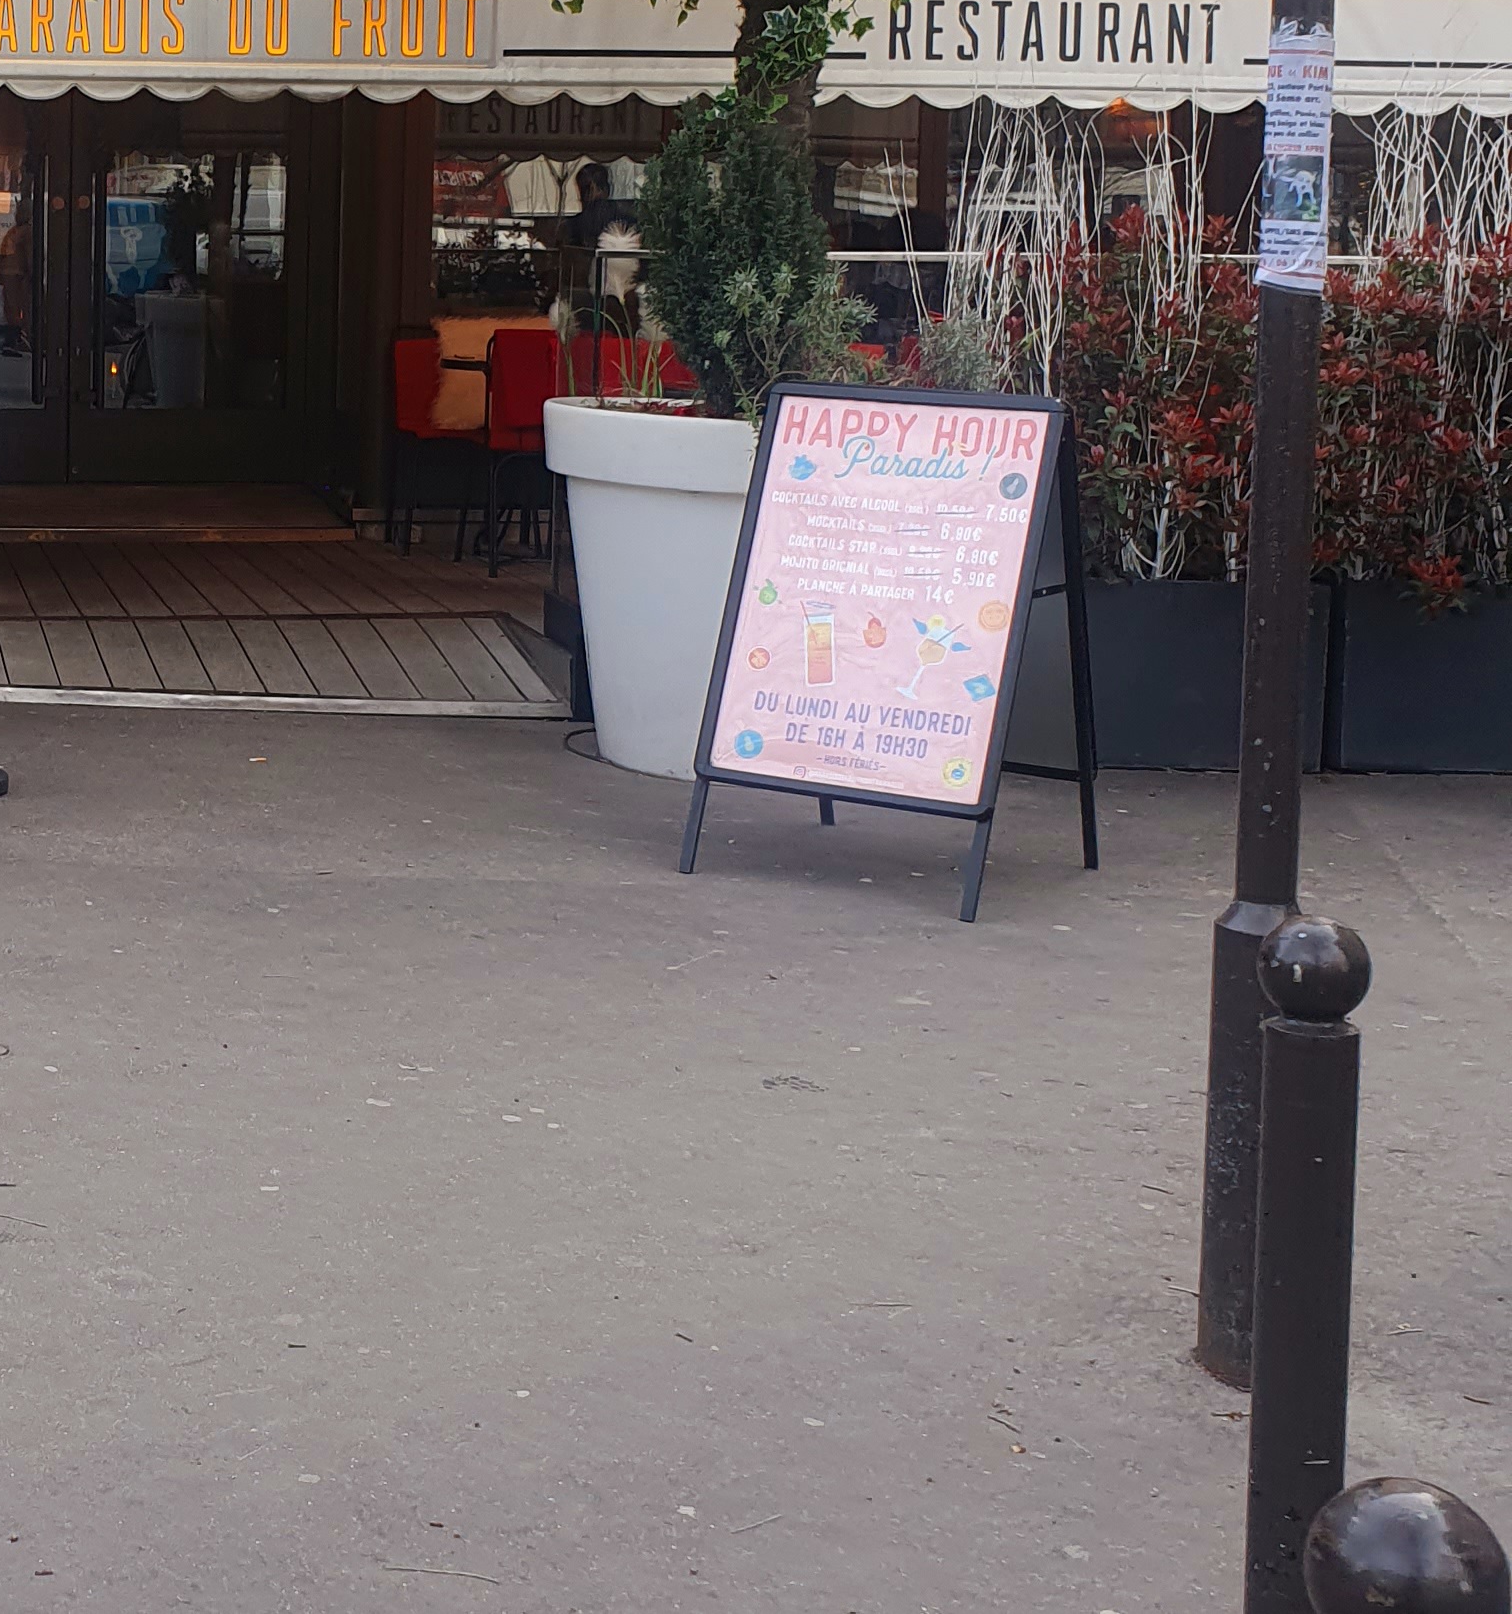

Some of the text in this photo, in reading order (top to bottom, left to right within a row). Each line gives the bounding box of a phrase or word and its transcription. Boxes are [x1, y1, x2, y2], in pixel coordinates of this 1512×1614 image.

[888, 0, 1222, 65] RESTAURANT
[1303, 65, 1328, 80] KIM
[783, 404, 1038, 461] HAPPY HOUR
[834, 435, 969, 480] Paradis
[771, 490, 827, 506] COCKTAILS
[830, 496, 857, 509] AVEC
[861, 497, 901, 513] ALCOOL
[984, 503, 1028, 524] 7.50€
[806, 515, 865, 532] MOCKTAILS
[788, 533, 845, 552] COCKTAILS
[848, 540, 877, 555] STAR
[780, 554, 819, 571] MOJITO
[797, 577, 846, 595] PLANCHE
[860, 583, 916, 602] PARTAGER
[753, 690, 973, 737] DU LUNDI AU VENDREDI
[785, 722, 810, 744] DE
[817, 726, 847, 750] 16H
[875, 733, 929, 760] 19H30
